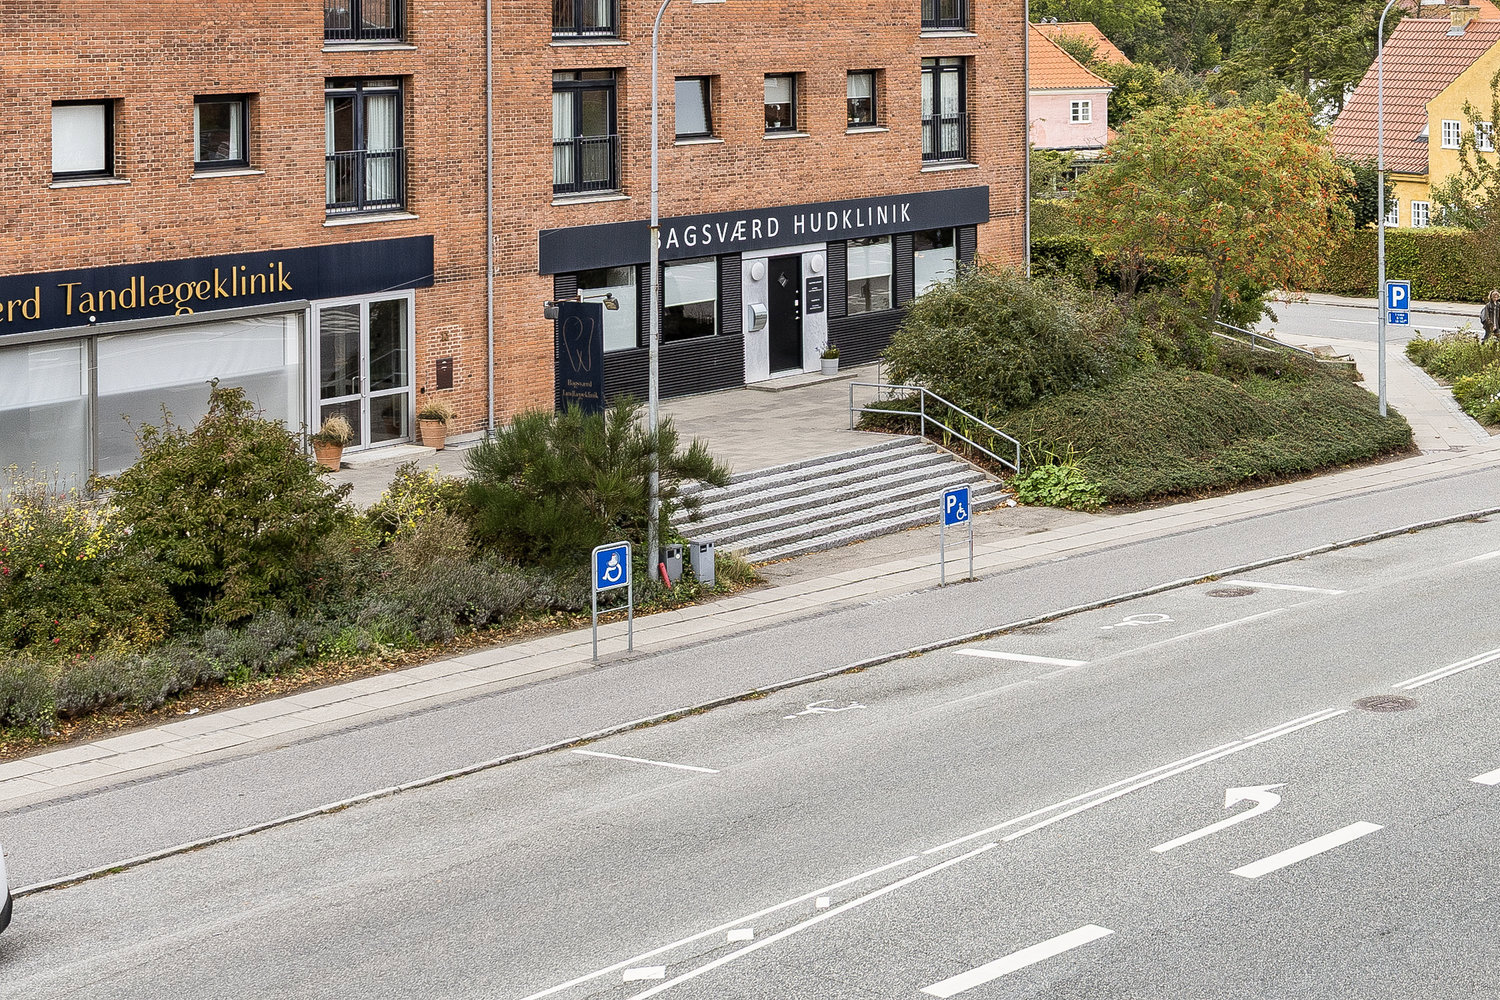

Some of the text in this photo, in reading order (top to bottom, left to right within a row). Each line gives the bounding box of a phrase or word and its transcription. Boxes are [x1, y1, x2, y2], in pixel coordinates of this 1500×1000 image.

[794, 203, 911, 235] HUDKLINIK
[0, 261, 293, 322] rd Tandlægeklinik
[1392, 286, 1405, 307] P
[946, 495, 957, 513] P
